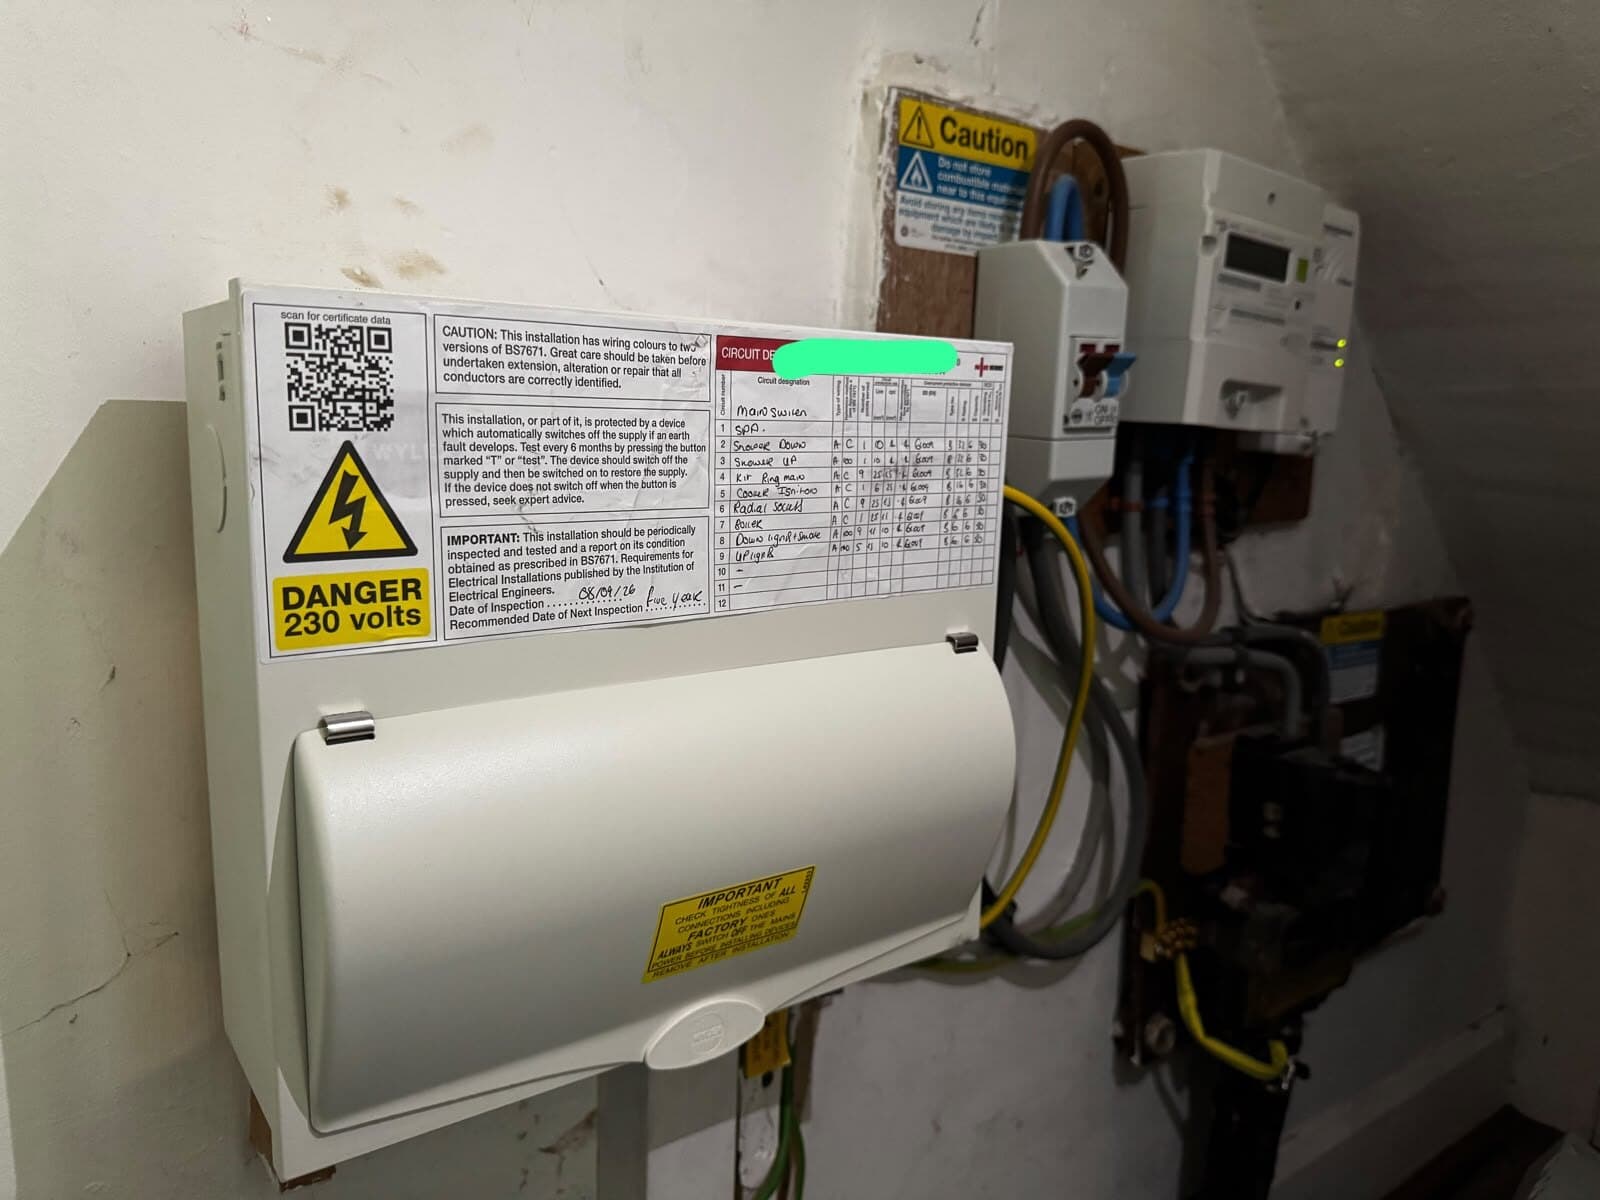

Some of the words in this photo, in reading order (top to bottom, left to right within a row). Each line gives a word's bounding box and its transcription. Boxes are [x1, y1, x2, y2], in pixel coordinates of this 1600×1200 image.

[940, 115, 1028, 160] Caution
[281, 312, 304, 320] scan
[307, 311, 320, 320] for
[323, 313, 368, 323] certificate
[371, 316, 391, 324] data
[442, 325, 497, 340] CAUTION:
[500, 329, 522, 341] This
[525, 331, 580, 345] installation
[583, 335, 600, 346] has
[602, 337, 630, 350] wiring
[633, 339, 666, 350] colours
[668, 341, 678, 351] to
[443, 342, 488, 354] versions
[491, 344, 502, 355] of
[505, 344, 547, 357] BS7671.
[550, 346, 578, 359] Great
[580, 351, 601, 360] care
[604, 350, 635, 362] should
[638, 352, 649, 362] be
[652, 354, 676, 364] taken
[678, 355, 706, 366] before
[721, 347, 760, 360] CIRCUIT
[443, 357, 504, 369] undertaken
[508, 360, 560, 373] extension,
[563, 362, 608, 374] alteration
[611, 366, 621, 375] or
[623, 365, 650, 378] repair
[652, 365, 669, 377] that
[672, 368, 681, 378] all
[443, 372, 505, 383] conductors
[508, 376, 525, 384] are
[528, 376, 573, 388] correctly
[575, 376, 621, 388] identified.
[758, 376, 777, 385] Circuit
[778, 378, 810, 386] designation
[442, 413, 464, 424] This
[467, 414, 525, 426] installation,
[528, 418, 538, 426] or
[540, 416, 560, 428] part
[562, 416, 572, 426] of
[574, 416, 582, 427] it,
[585, 417, 592, 426] is
[595, 418, 637, 428] protected
[639, 418, 650, 430] by
[659, 418, 685, 428] device
[721, 424, 724, 432] 1
[442, 427, 474, 438] which
[476, 428, 542, 441] automatically
[545, 429, 586, 439] switches
[588, 430, 600, 440] off
[602, 430, 616, 439] the
[618, 429, 647, 442] supply
[649, 430, 654, 440] if
[657, 432, 668, 441] an
[668, 430, 690, 440] earth
[442, 441, 466, 452] fault
[469, 441, 517, 454] develops.
[520, 441, 540, 453] Test
[543, 444, 568, 454] every
[570, 442, 576, 452] 6
[579, 442, 612, 452] months
[614, 442, 625, 454] by
[627, 441, 663, 456] pressing
[665, 442, 678, 452] the
[680, 443, 706, 452] button
[721, 440, 725, 448] 2
[720, 456, 725, 465] 3
[445, 496, 490, 509] pressed,
[493, 495, 516, 506] seek
[519, 493, 550, 508] expert
[552, 492, 584, 504] advice.
[720, 490, 725, 498] 5
[720, 505, 724, 513] 6
[734, 500, 767, 513] Radial
[720, 520, 724, 528] 7
[447, 533, 520, 546] IMPORTANT:
[525, 531, 544, 542] This
[547, 530, 598, 542] installation
[601, 528, 631, 540] should
[634, 528, 645, 536] be
[647, 525, 696, 540] periodically
[720, 536, 724, 544] 8
[448, 547, 500, 562] inspected
[503, 546, 523, 557] and
[526, 544, 557, 556] tested
[560, 542, 578, 554] and
[579, 545, 586, 554] a
[589, 542, 618, 554] report
[633, 540, 644, 550] its
[646, 538, 685, 549] condition
[720, 552, 724, 560] 9
[448, 561, 495, 574] obtained
[498, 563, 511, 571] as
[513, 556, 567, 572] prescribed
[570, 556, 578, 566] in
[581, 552, 619, 566] BS7671.
[621, 549, 680, 564] Requirements
[682, 550, 694, 559] for
[448, 575, 498, 588] Electrical
[501, 569, 562, 584] Installations
[564, 567, 610, 582] published
[612, 567, 624, 578] by
[626, 564, 640, 576] the
[643, 562, 684, 574] Institution
[686, 561, 694, 571] of
[718, 568, 726, 576] 10
[282, 578, 421, 610] DANGER
[449, 588, 498, 602] Electrical
[502, 586, 555, 599] Engineers.
[718, 584, 724, 592] 11
[450, 605, 474, 616] Date
[478, 602, 488, 614] of
[491, 599, 544, 614] Inspection
[718, 599, 726, 607] 12
[285, 610, 339, 637] 230
[350, 605, 421, 630] volts
[450, 612, 529, 630] Recommended
[532, 611, 556, 622] Date
[558, 609, 568, 619] of
[570, 608, 592, 618] Next
[595, 603, 643, 617] Inspection
[698, 878, 782, 909] IMPORTANT
[675, 912, 706, 925] CHECK
[712, 897, 760, 915] TIGHTNESS
[779, 885, 796, 897] ALL
[678, 911, 741, 933] CONNECTIONS
[746, 897, 790, 914] INCLUDING
[688, 917, 747, 941] FACTORY
[658, 942, 692, 960] ALWAYS
